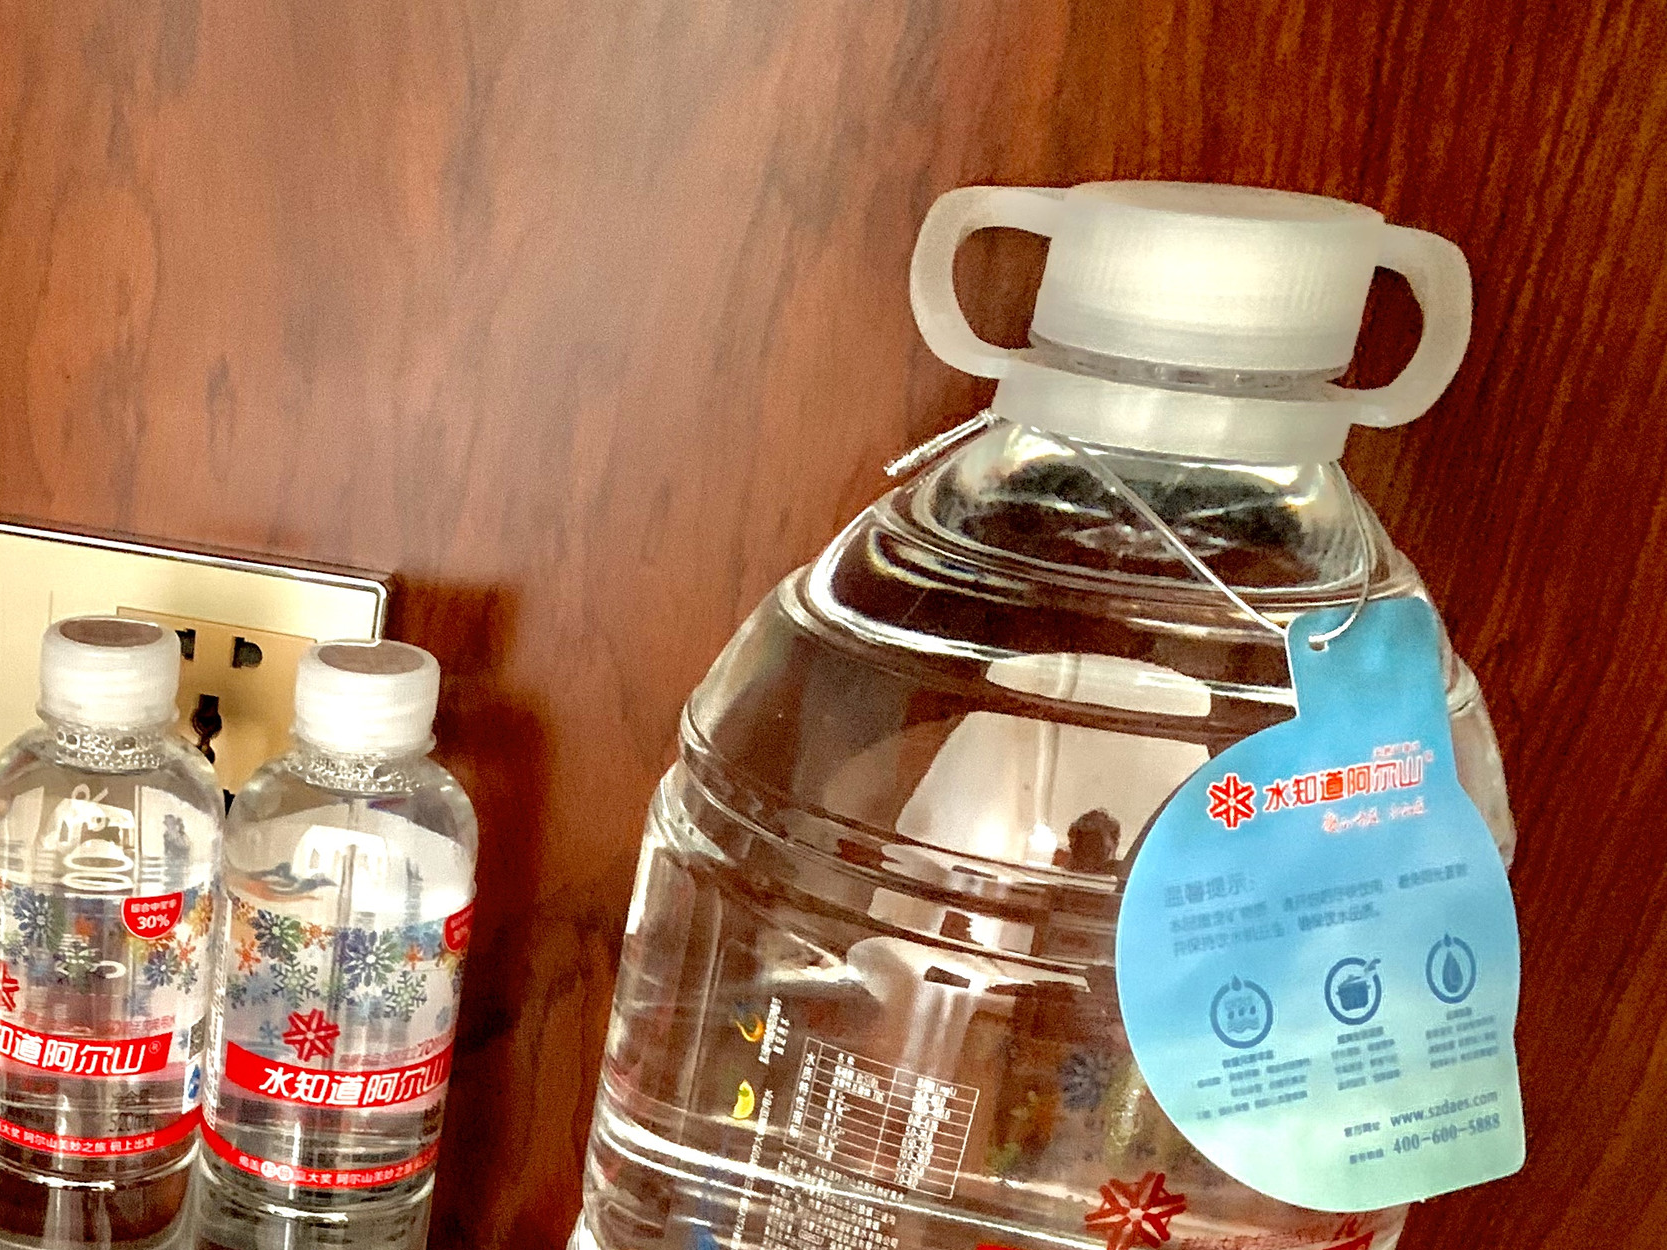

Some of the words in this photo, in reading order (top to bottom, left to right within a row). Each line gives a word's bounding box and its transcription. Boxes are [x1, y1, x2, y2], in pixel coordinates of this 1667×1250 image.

[1263, 756, 1423, 812] 水知道阿尔山
[137, 914, 171, 930] 30%
[259, 1058, 444, 1106] 水知道阿尔山
[1393, 1112, 1501, 1155] 400-600-5888
